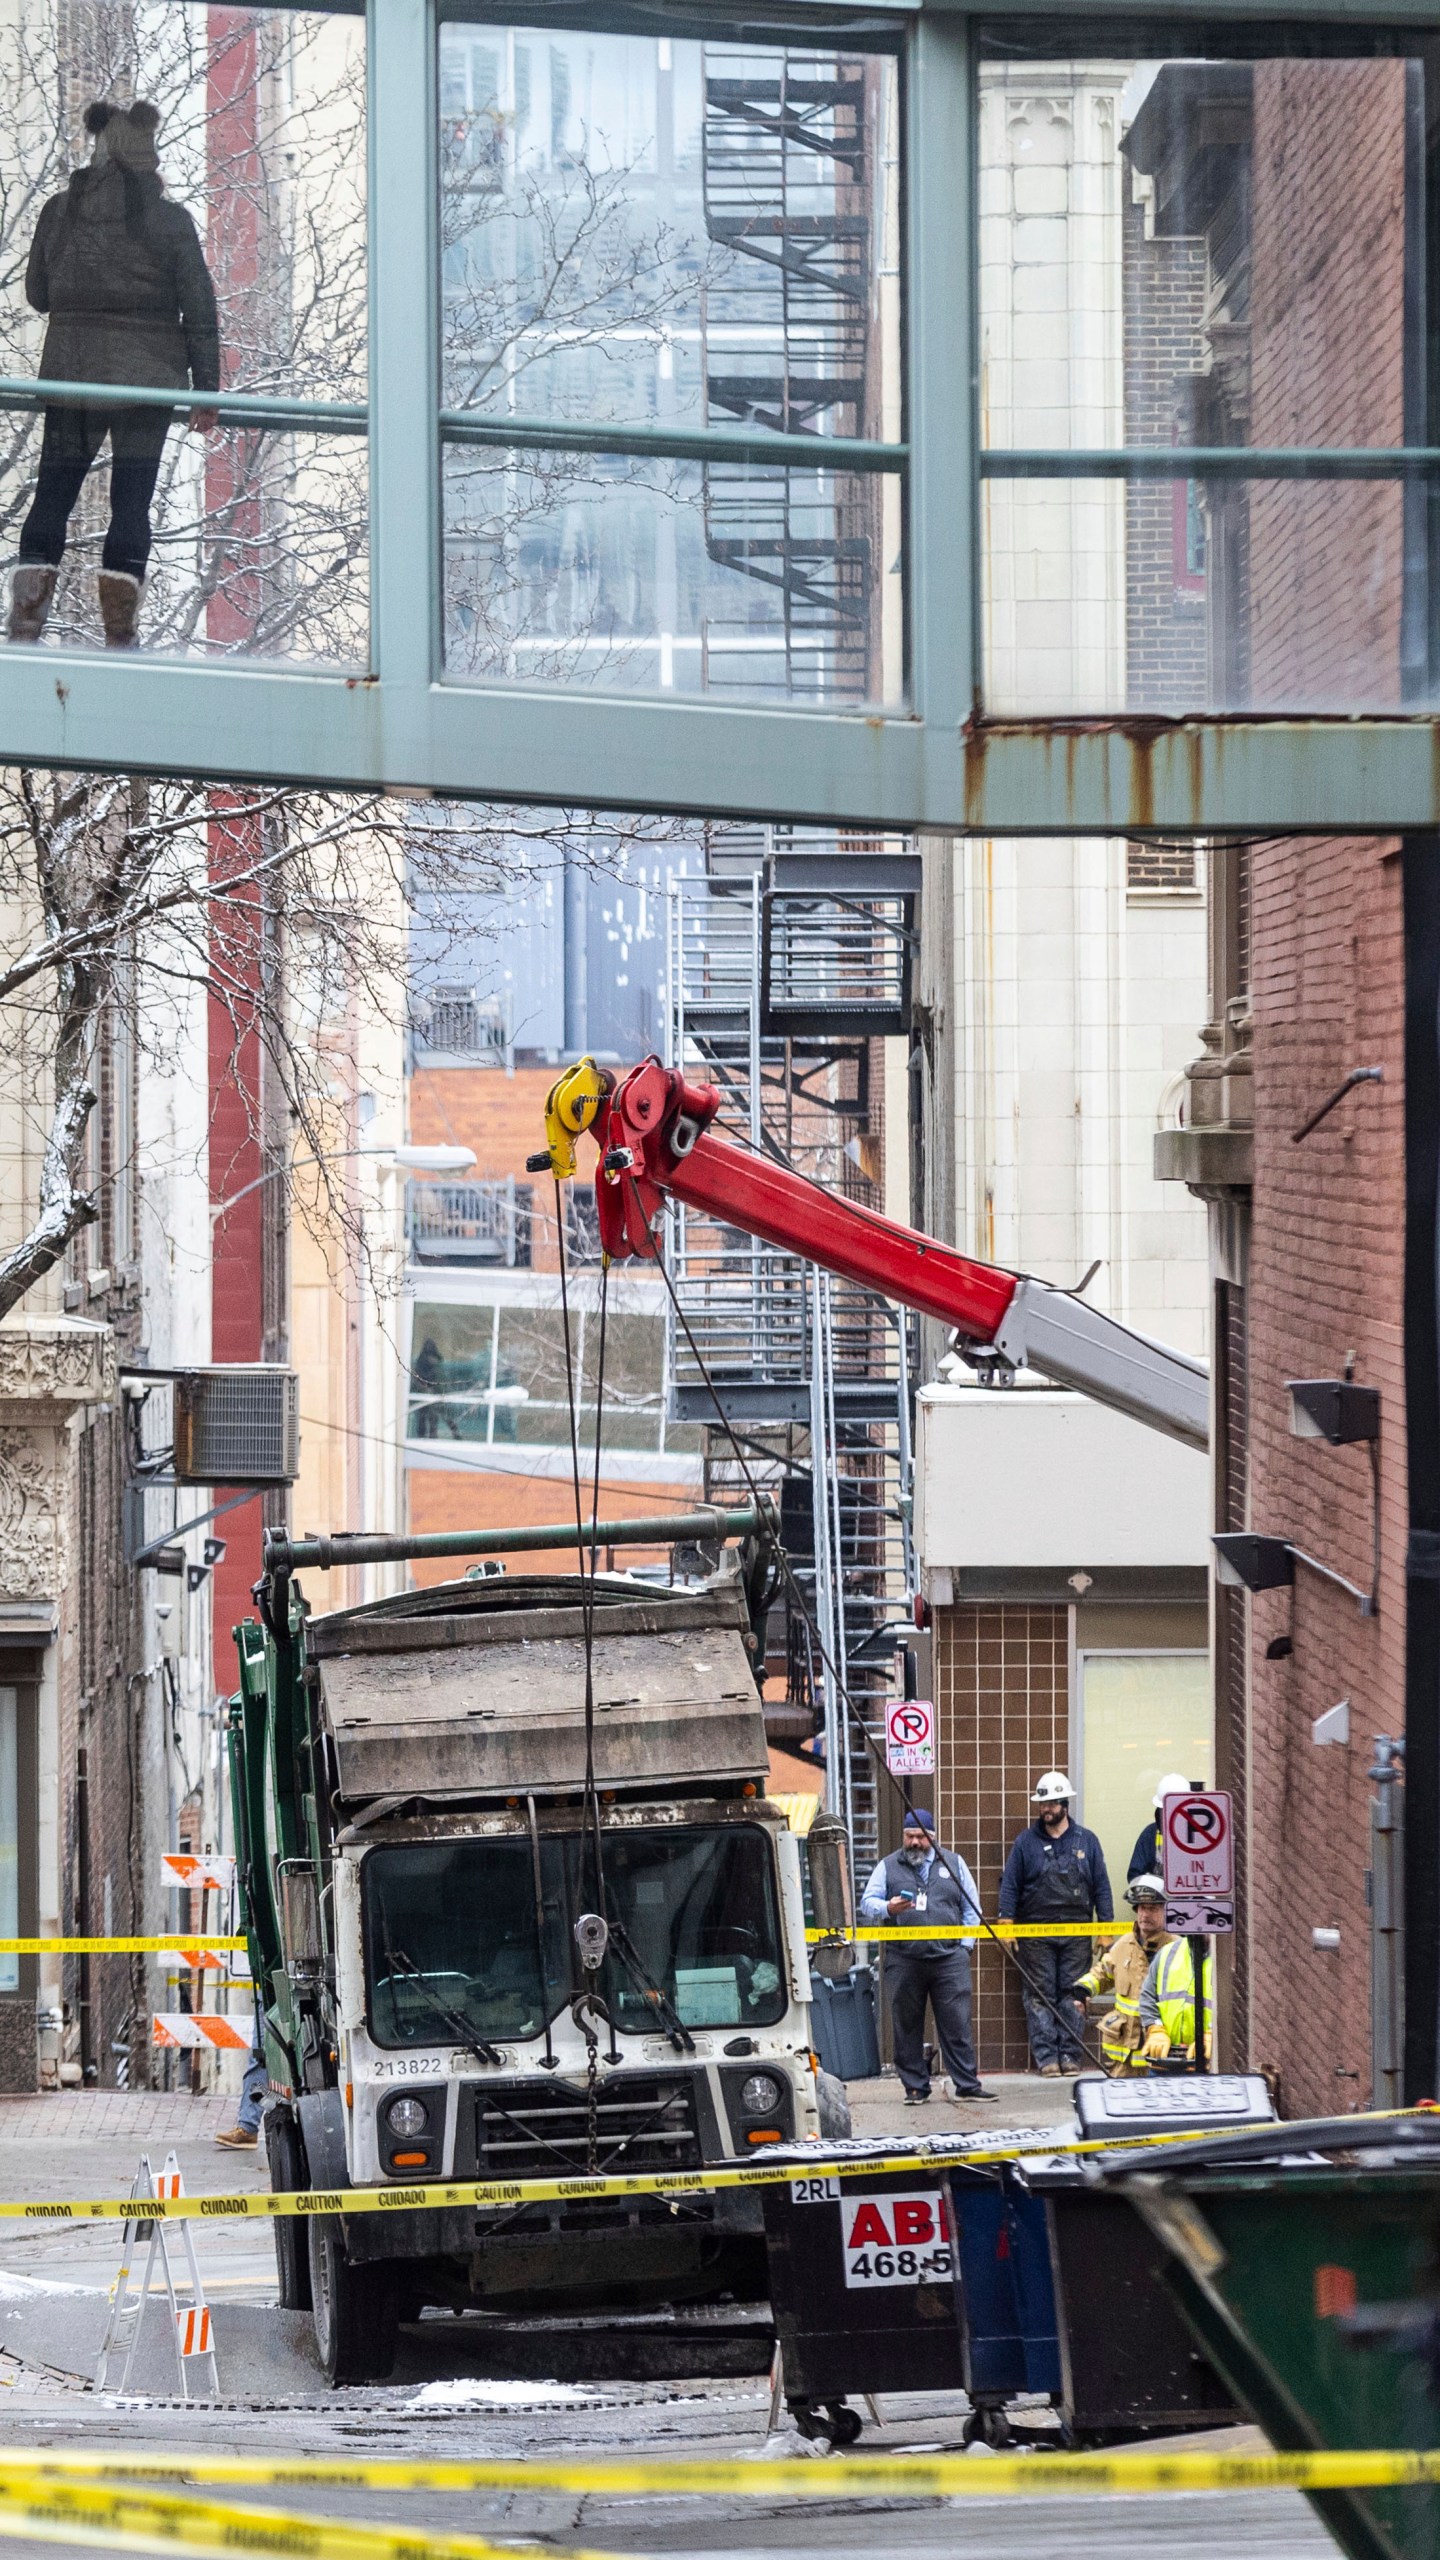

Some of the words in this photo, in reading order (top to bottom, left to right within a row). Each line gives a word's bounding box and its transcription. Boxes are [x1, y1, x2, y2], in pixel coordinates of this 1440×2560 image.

[907, 1747, 917, 1756] IN
[896, 1758, 928, 1767] ALLEY
[1191, 1860, 1205, 1873] IN
[1175, 1874, 1223, 1889] ALLEY
[374, 2058, 441, 2076] 213822
[25, 2205, 72, 2218] CUIDADO
[119, 2202, 166, 2217] CAUTION
[200, 2198, 248, 2216] CUIDADO
[295, 2194, 342, 2212] CAUTION
[378, 2188, 426, 2206] CUIDADO
[474, 2183, 522, 2201] CAUTION
[557, 2179, 606, 2195] CUIDADO
[654, 2174, 703, 2189] CAUTION
[795, 2178, 840, 2202] 2RL
